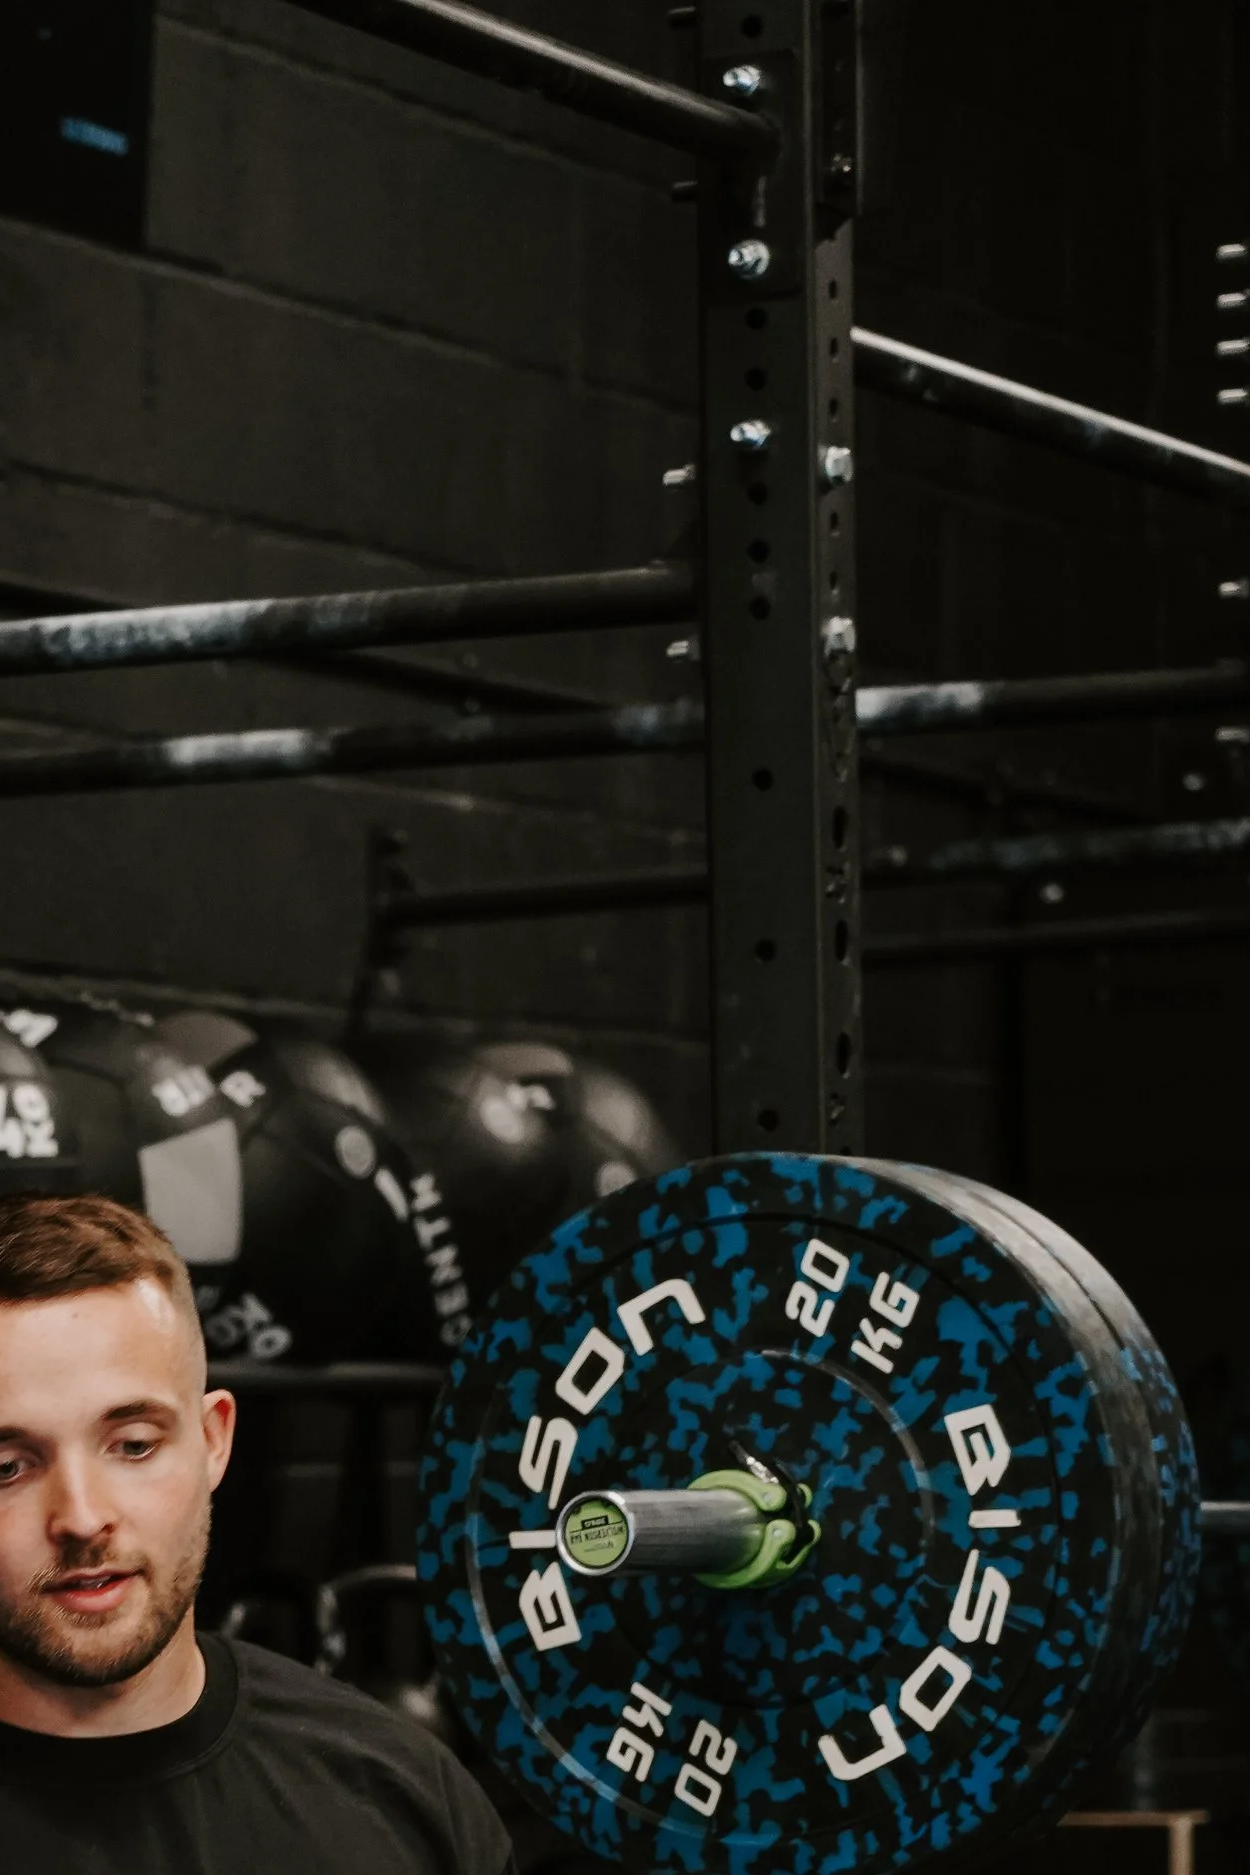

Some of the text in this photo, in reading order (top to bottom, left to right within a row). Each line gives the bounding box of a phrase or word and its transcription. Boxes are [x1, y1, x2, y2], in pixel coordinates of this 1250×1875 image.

[785, 1237, 851, 1339] 20
[850, 1270, 921, 1374] KG
[509, 1277, 707, 1653] BISON
[817, 1404, 1022, 1782] BISON
[606, 1681, 673, 1783] KG
[673, 1717, 738, 1818] 20
